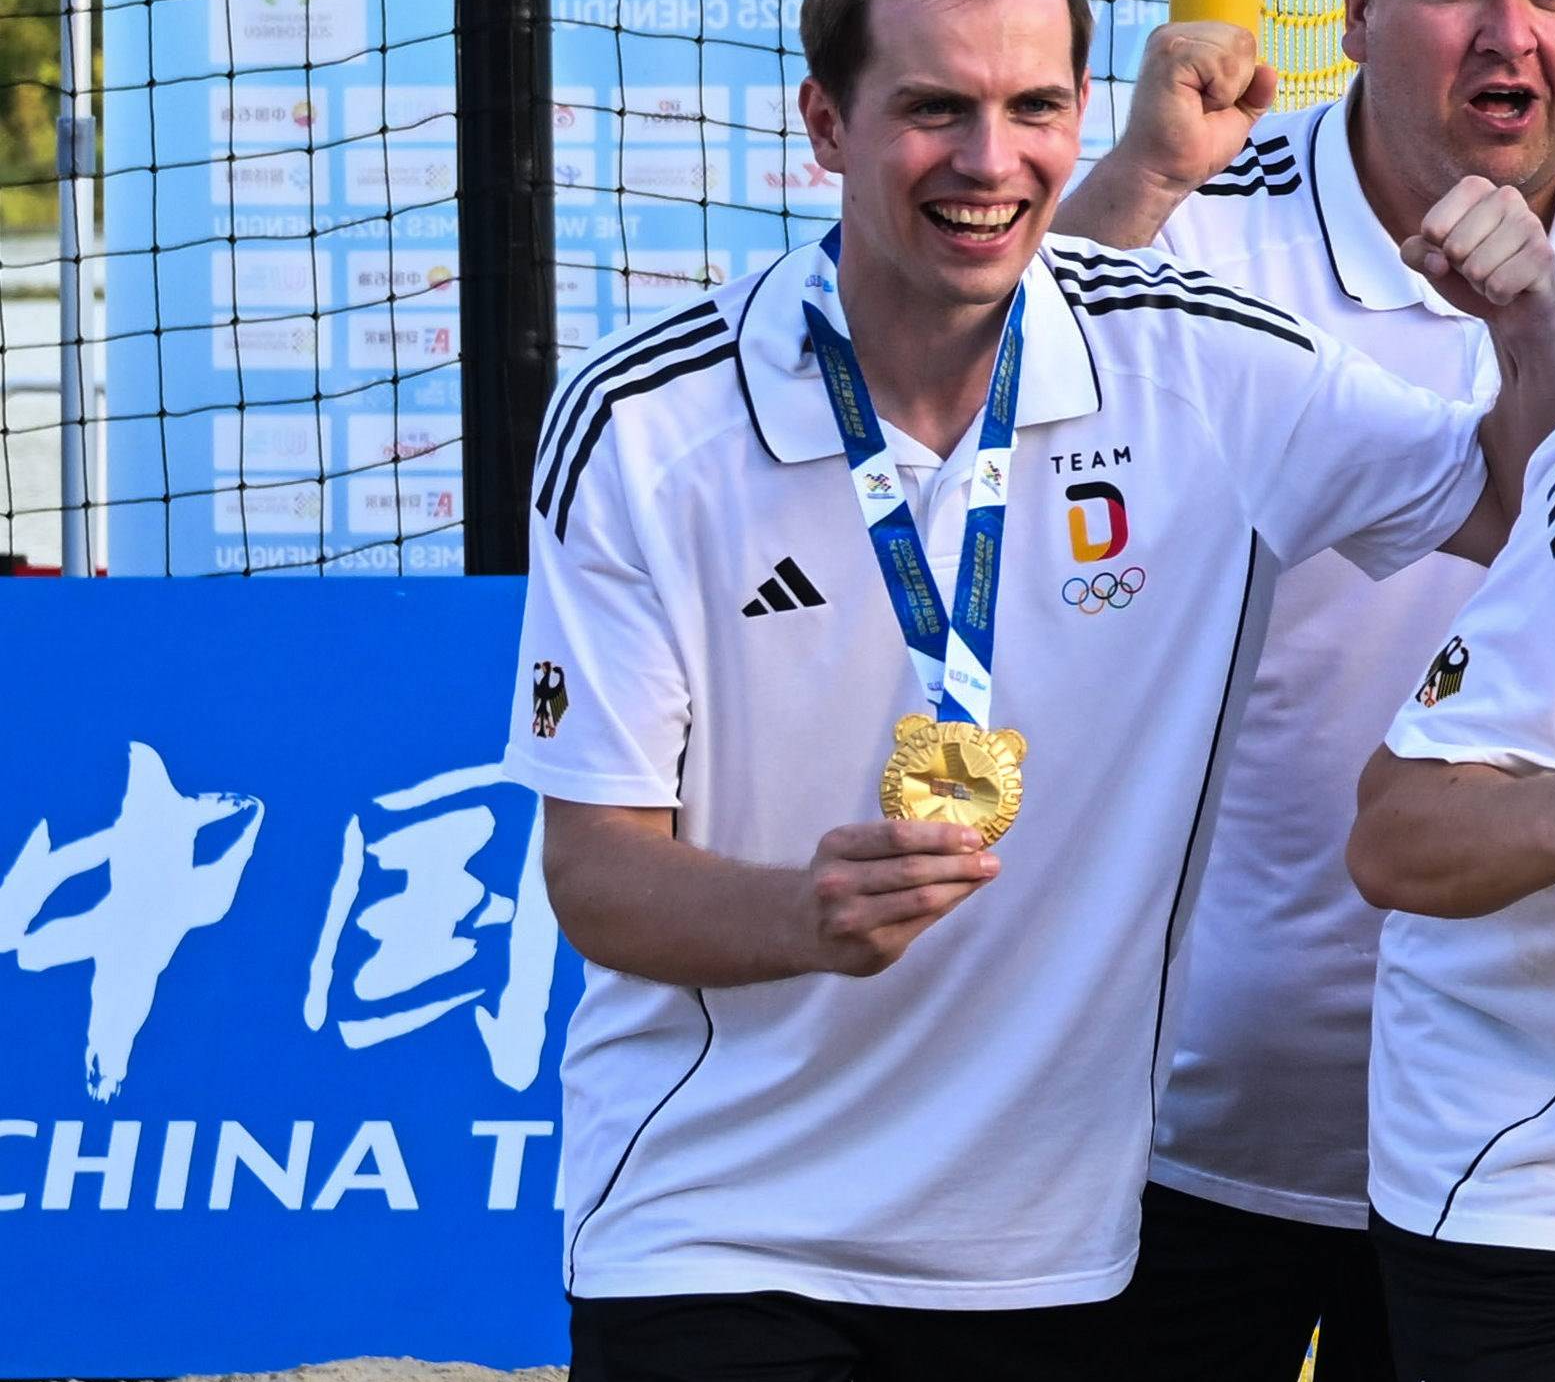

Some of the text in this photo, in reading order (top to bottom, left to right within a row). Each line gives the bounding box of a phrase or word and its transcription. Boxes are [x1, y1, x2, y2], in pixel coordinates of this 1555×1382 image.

[1051, 446, 1131, 474] TEAM
[0, 741, 562, 1101] 中国
[473, 1120, 566, 1210] T
